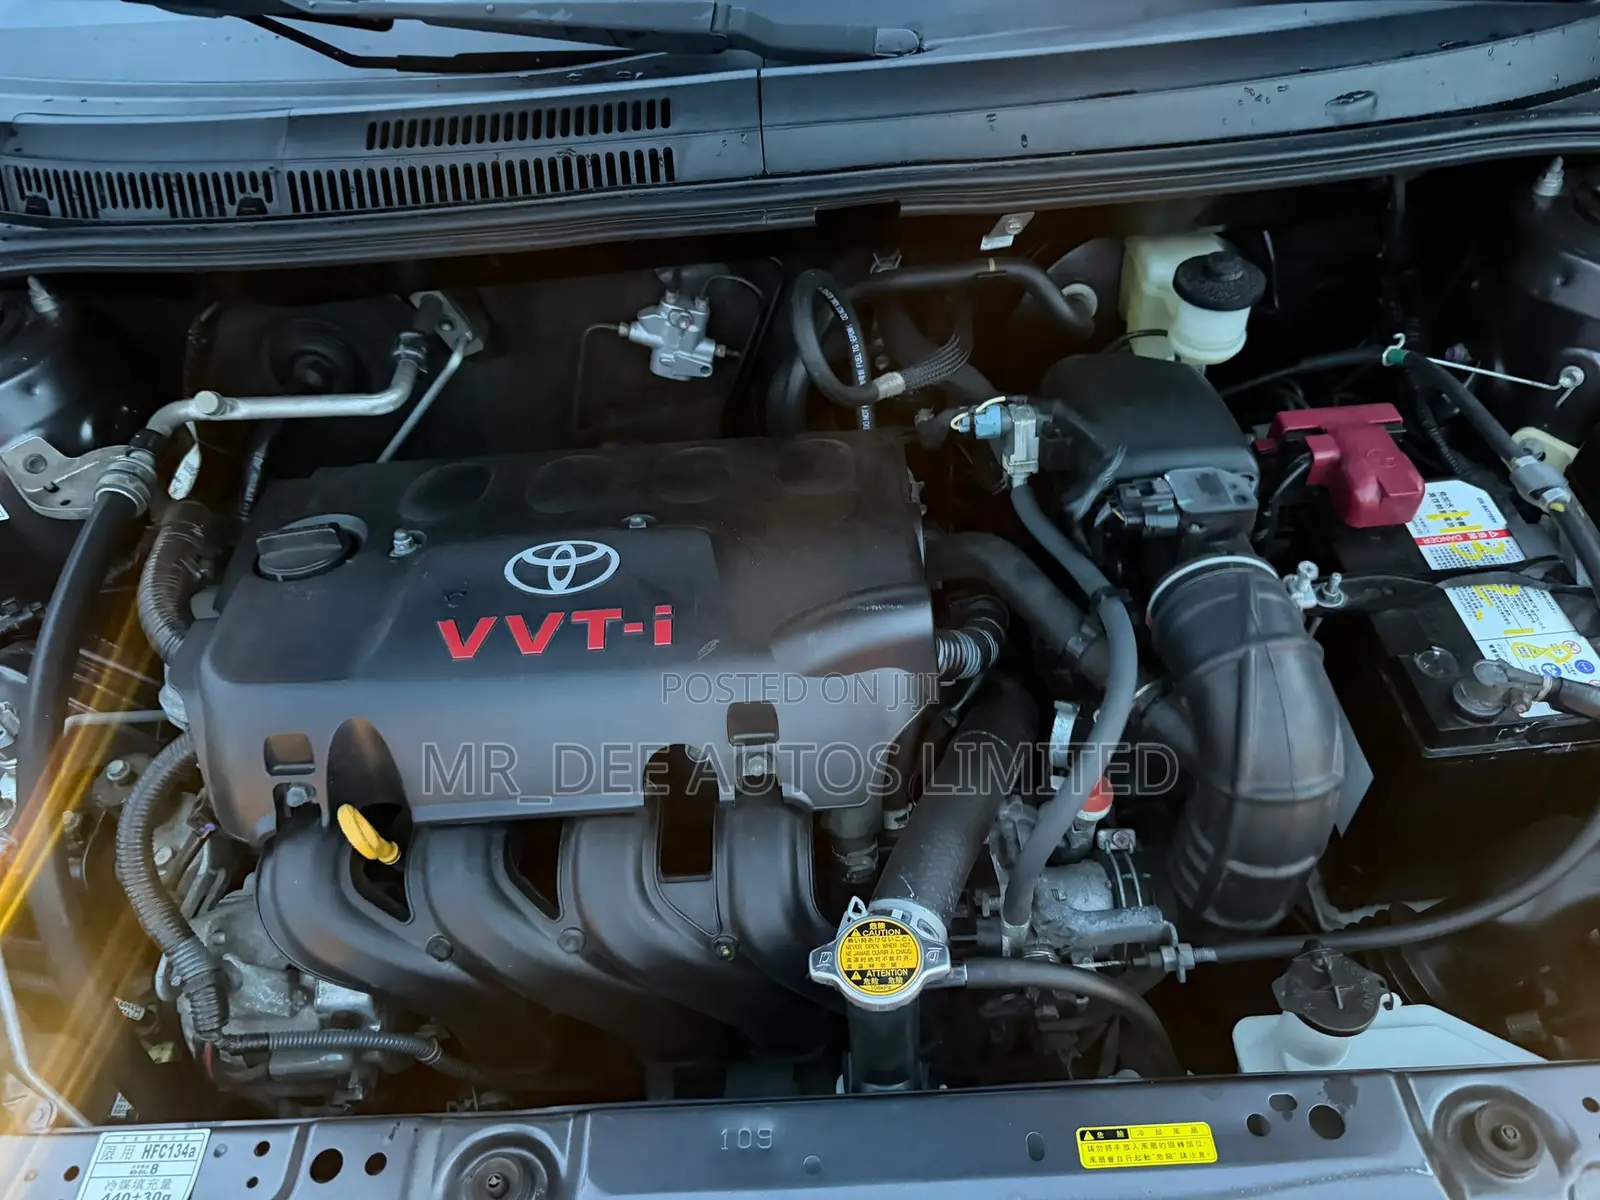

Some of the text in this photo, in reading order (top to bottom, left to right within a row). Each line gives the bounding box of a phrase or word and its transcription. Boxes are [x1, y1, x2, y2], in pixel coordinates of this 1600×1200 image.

[437, 604, 673, 660] VVT-i
[862, 928, 901, 936] CAUTION
[866, 968, 908, 977] ATTENTION
[720, 1127, 773, 1150] 109
[141, 1142, 197, 1159] HFC134a
[149, 1163, 160, 1175] 8
